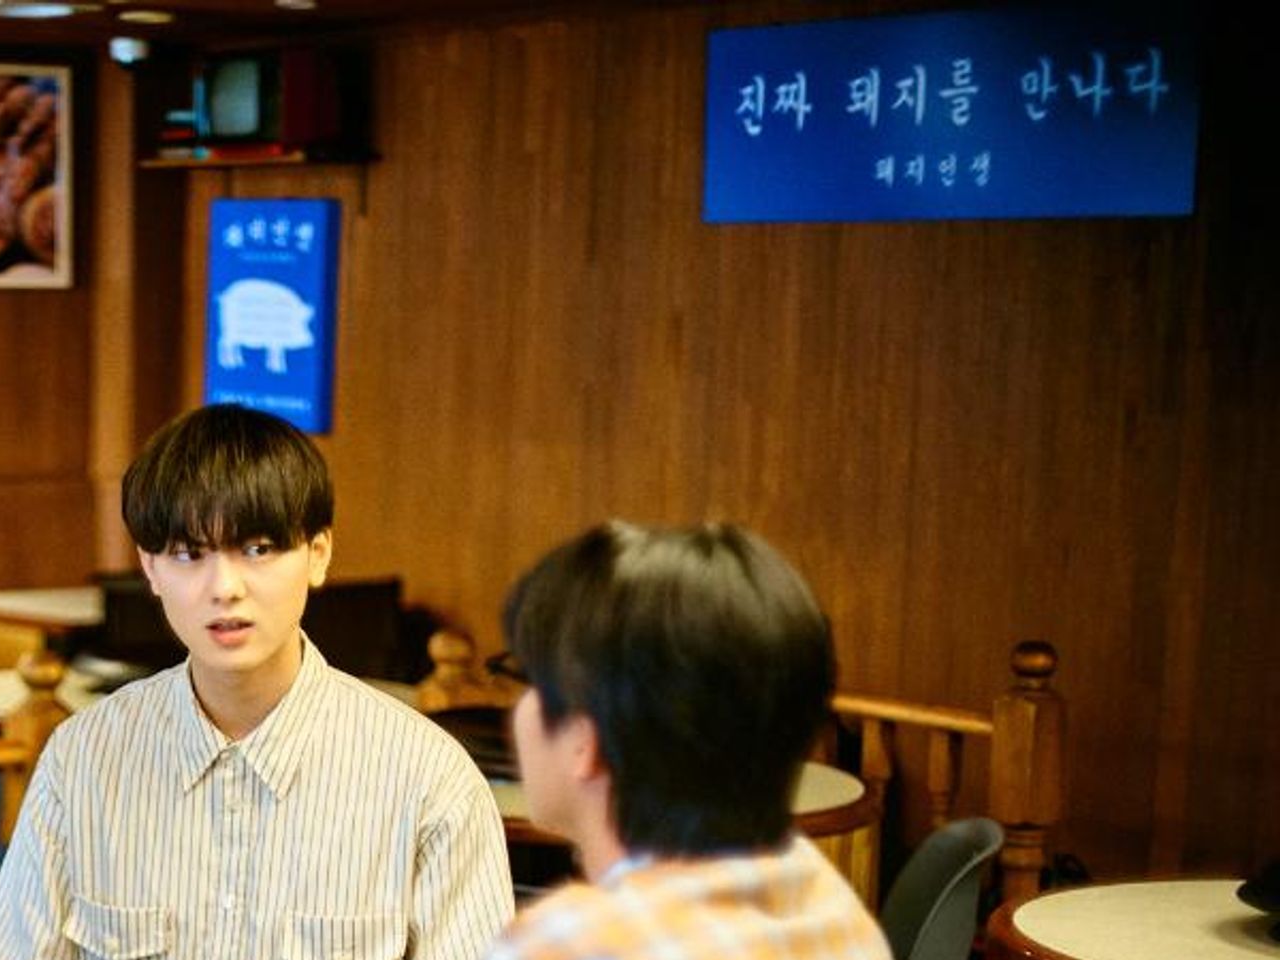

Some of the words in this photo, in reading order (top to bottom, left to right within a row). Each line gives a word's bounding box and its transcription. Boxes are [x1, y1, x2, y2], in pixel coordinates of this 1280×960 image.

[735, 71, 813, 137] 진짜
[845, 56, 980, 129] 돼지를
[1019, 46, 1170, 122] 만나다
[874, 150, 992, 188] 돼지인생
